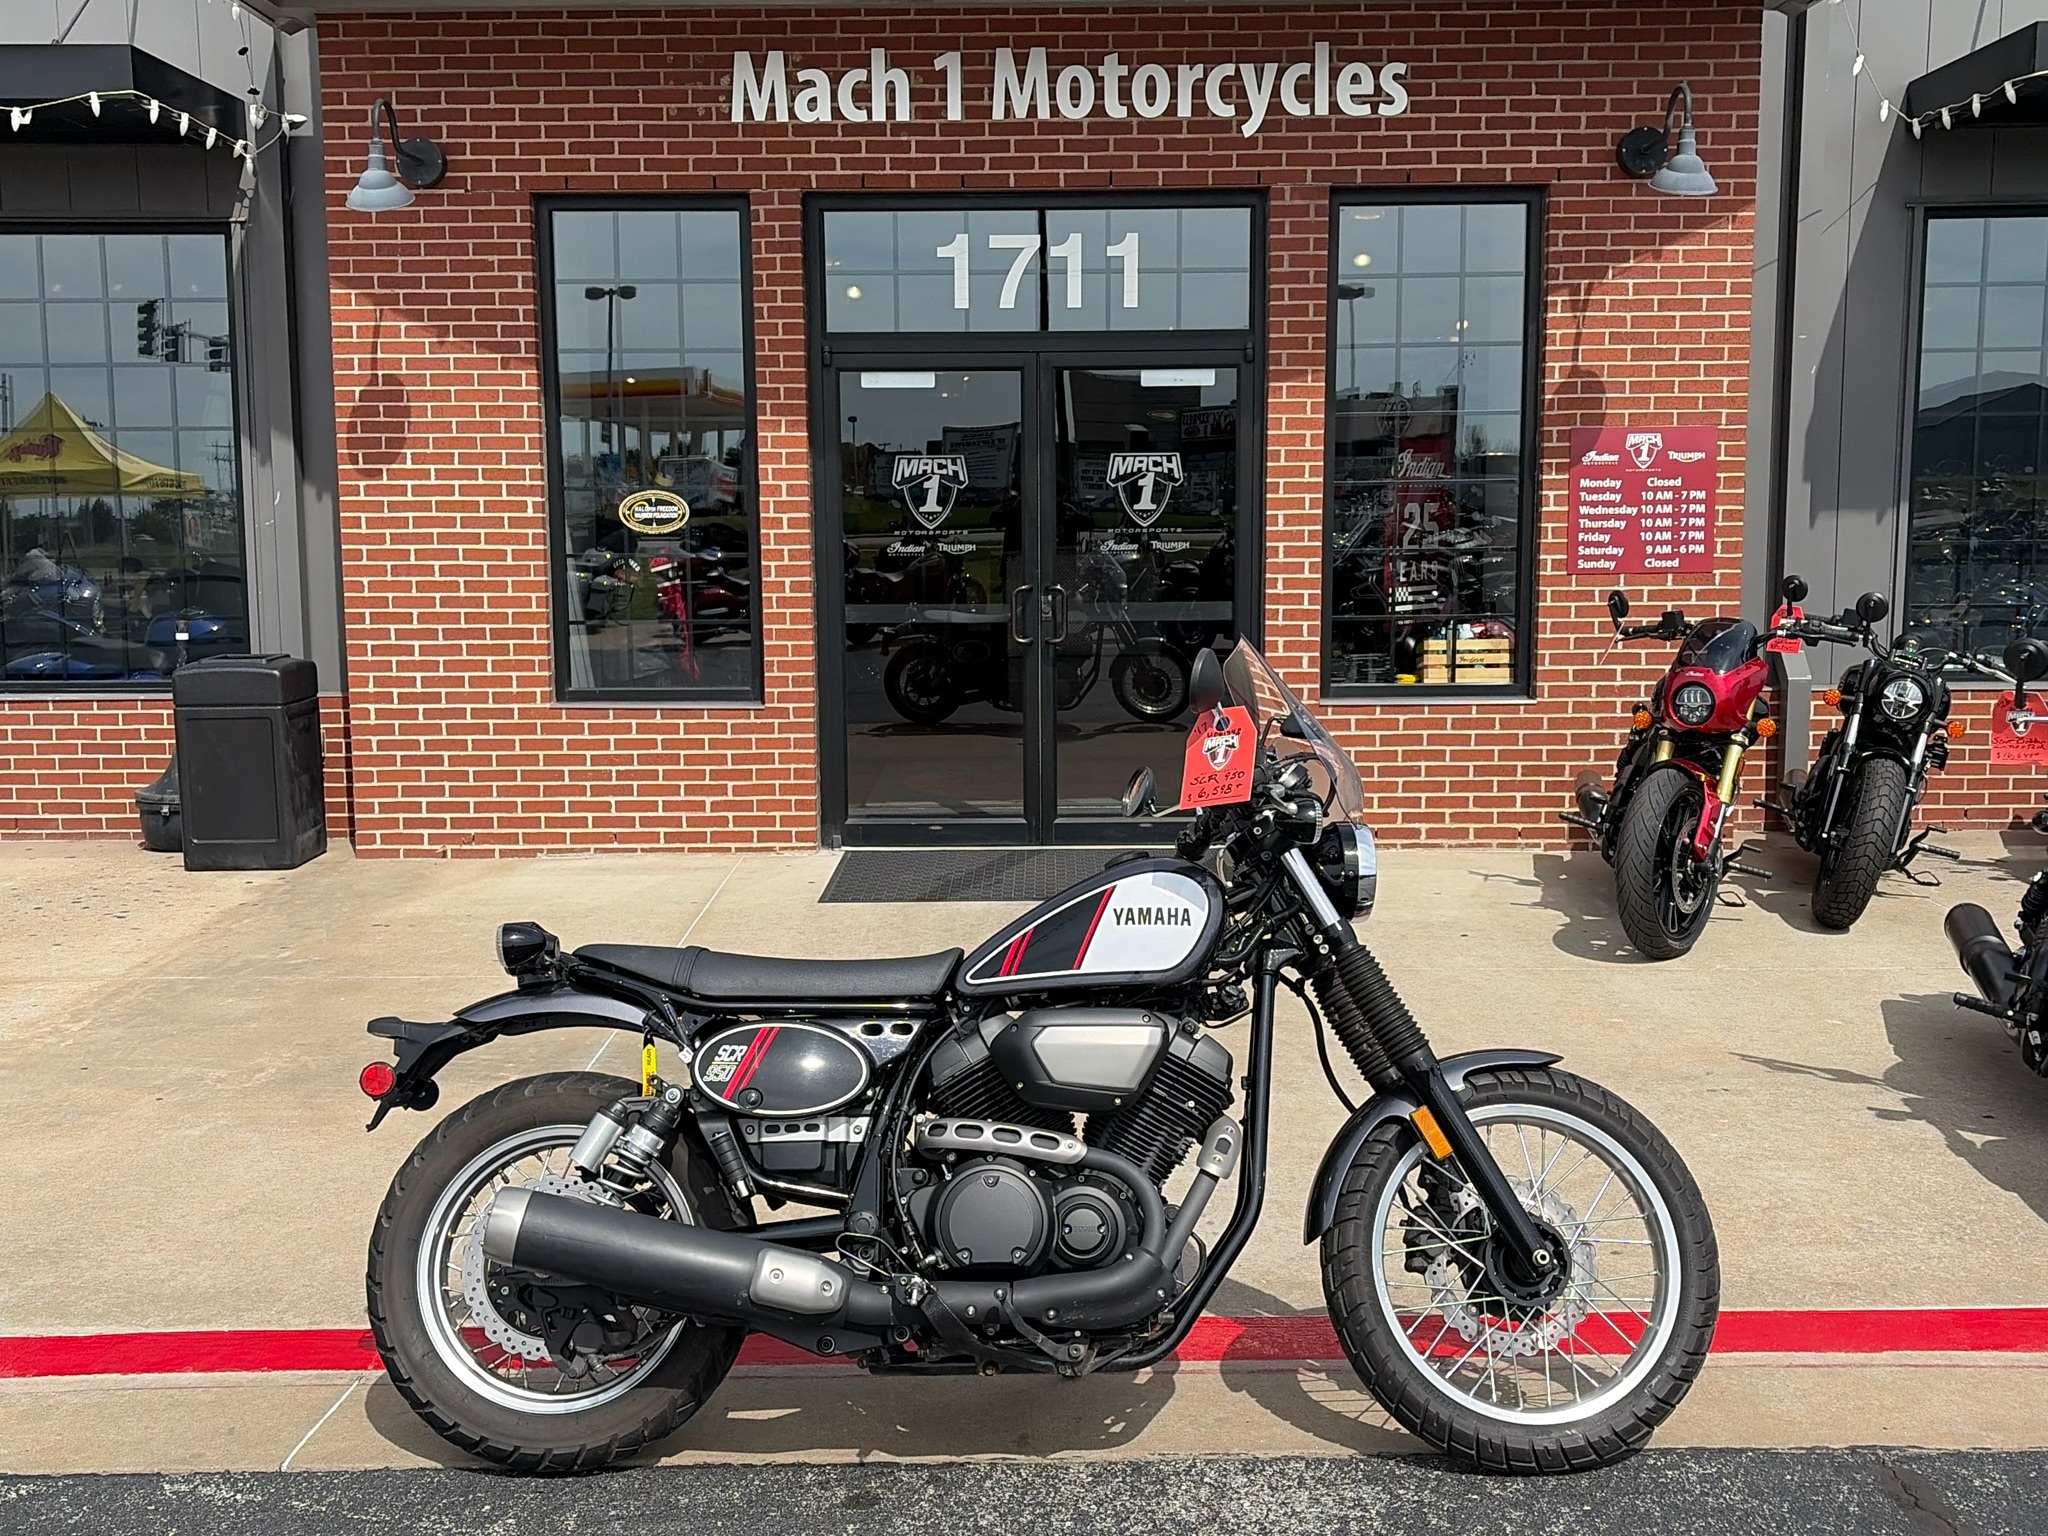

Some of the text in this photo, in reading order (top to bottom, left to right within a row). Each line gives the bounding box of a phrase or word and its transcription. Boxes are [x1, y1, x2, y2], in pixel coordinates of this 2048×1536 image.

[731, 41, 1409, 138] Mach 1 Motorcycles
[936, 232, 1139, 309] 1711
[1628, 434, 1659, 447] MACH
[1582, 451, 1620, 462] Indian
[1637, 444, 1650, 461] 1
[1667, 451, 1706, 462] TRIUMPH
[896, 458, 966, 482] MACH
[1111, 456, 1180, 481] MACH
[1392, 449, 1451, 478] Indian
[1579, 477, 1682, 489] Monday Closed
[918, 474, 943, 512] 1
[1133, 472, 1157, 510] 1
[1579, 491, 1622, 503] Tuesday
[1641, 491, 1654, 500] 10
[1655, 491, 1673, 500] AM
[1681, 491, 1688, 500] 7
[1689, 491, 1706, 500] PM
[1579, 505, 1638, 516] Wednesday
[1641, 504, 1654, 514] 10
[1655, 504, 1673, 514] AM
[1680, 504, 1687, 513] 7
[1689, 504, 1706, 513] PM
[1578, 518, 1627, 530] Thursday
[1640, 518, 1653, 527] 10
[1654, 518, 1672, 527] AM
[1680, 518, 1687, 527] 7
[1688, 518, 1705, 527] PM
[1578, 532, 1611, 543] Friday
[1640, 532, 1653, 541] 10
[1654, 532, 1672, 541] AM
[1679, 531, 1687, 540] 7
[1688, 531, 1705, 540] PM
[887, 541, 926, 553] Indian
[937, 542, 977, 554] TRIUMPH
[1100, 539, 1139, 551] Indian
[1150, 540, 1190, 552] TRIUMPH
[1577, 545, 1624, 557] Saturday
[1645, 545, 1653, 554] 9
[1654, 545, 1672, 554] AM
[1679, 545, 1687, 554] 6
[1688, 544, 1705, 553] PM
[1577, 558, 1679, 570] Sunday Closed
[1204, 735, 1238, 752] MACH
[1213, 745, 1226, 764] 1
[1190, 773, 1220, 786] SCR
[1224, 770, 1245, 781] 950
[1113, 907, 1192, 926] YAMAHA
[714, 1045, 748, 1062] SCR
[703, 1065, 737, 1082] 950
